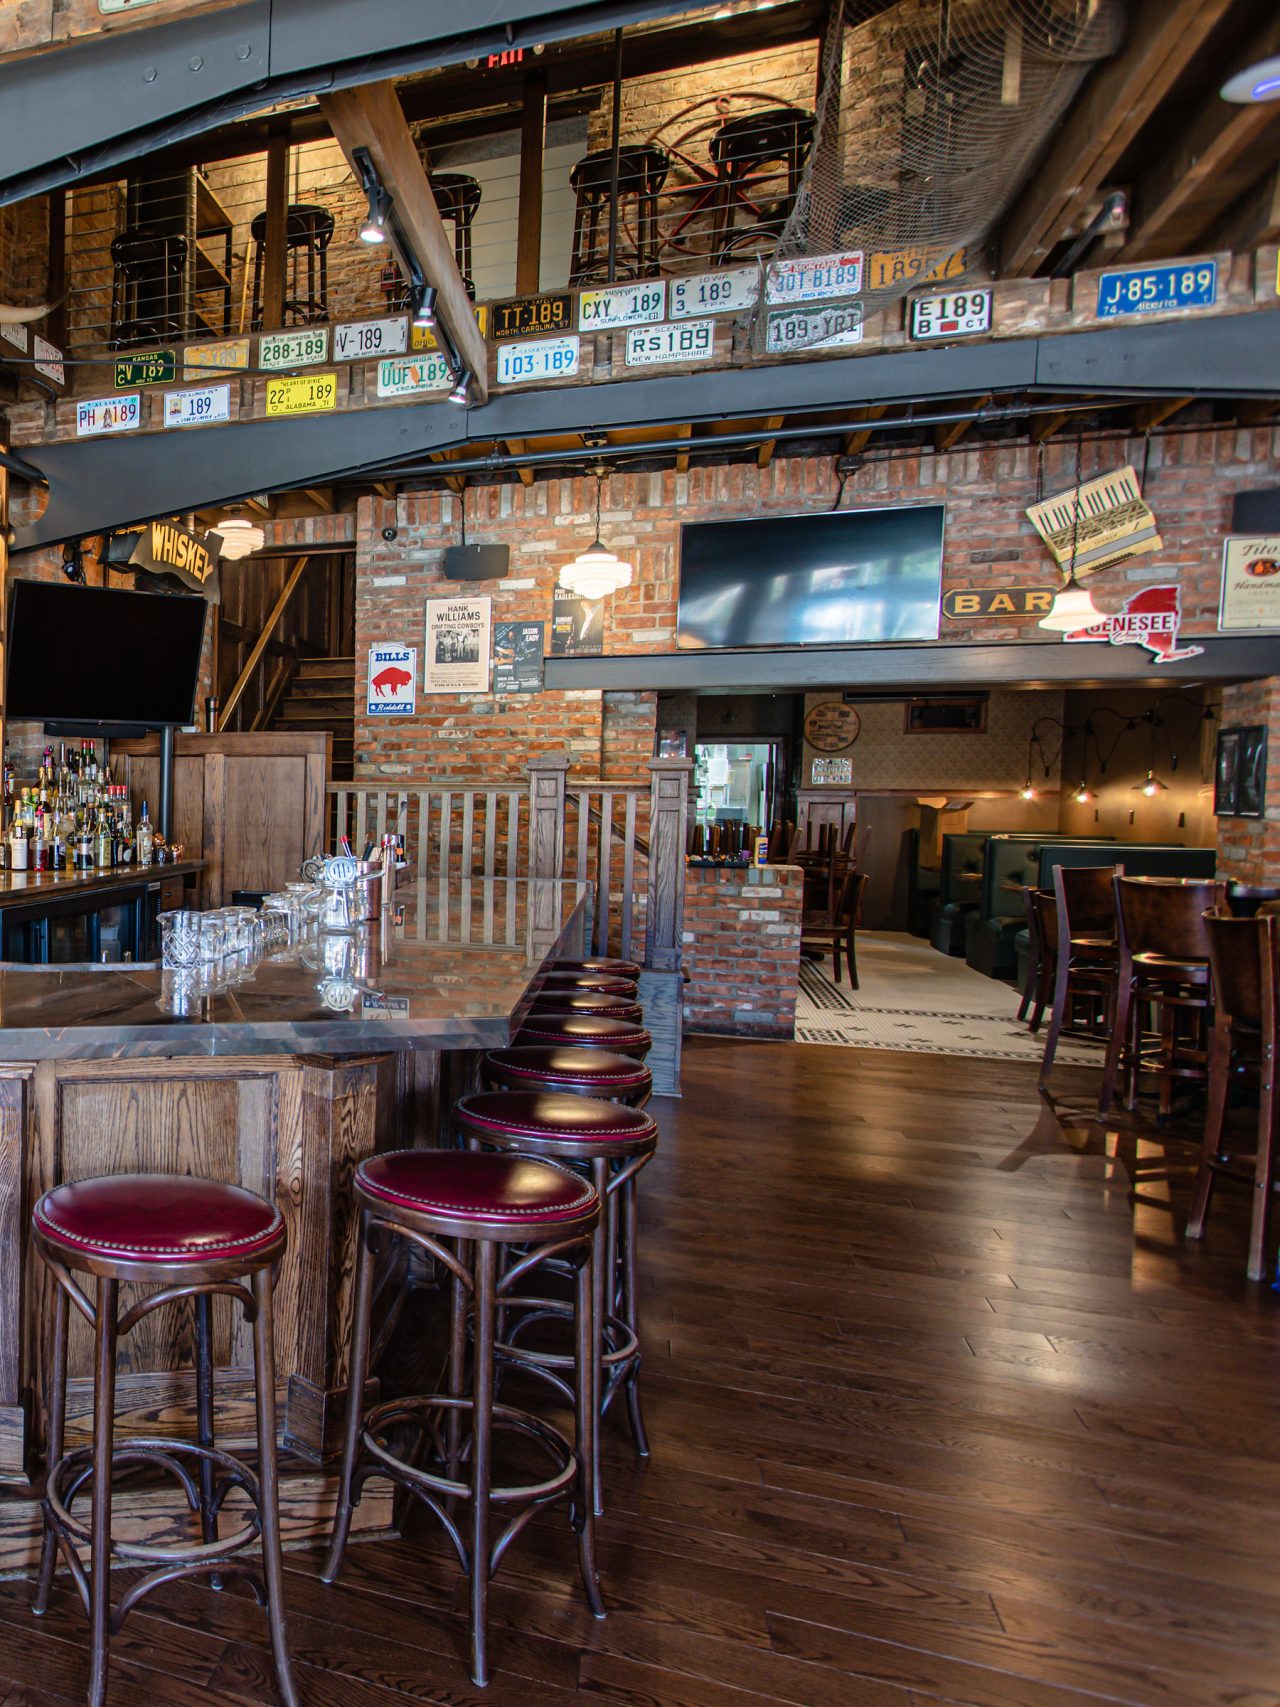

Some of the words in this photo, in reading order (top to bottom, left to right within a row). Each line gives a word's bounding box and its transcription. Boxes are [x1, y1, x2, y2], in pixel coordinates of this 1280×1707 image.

[699, 272, 730, 285] IOWA
[698, 280, 732, 303] 189
[582, 299, 612, 321] CXY
[630, 292, 661, 314] 189
[935, 293, 986, 320] 189
[1133, 299, 1178, 312] Alberta
[600, 312, 643, 325] SUNFLOWER
[965, 317, 985, 329] CT
[495, 328, 519, 337] NORTH
[520, 321, 556, 334] CAROLINA
[654, 322, 688, 334] SCENIC
[414, 338, 434, 347] OHIO
[133, 354, 159, 363] KANSAS
[398, 356, 433, 365] FLORIDA
[631, 354, 652, 363] NEW
[655, 349, 709, 361] HAMPSHIRE
[142, 359, 165, 379] 189
[417, 361, 448, 384] 189
[269, 389, 285, 405] 22
[309, 383, 332, 401] 189
[189, 396, 212, 417] 189
[285, 401, 317, 411] ALABAMA
[79, 408, 96, 428] PH
[112, 403, 137, 424] 189
[151, 521, 214, 585] WHISKEY
[447, 605, 469, 613] HANK
[953, 591, 1054, 615] BAR
[436, 611, 481, 622] WILLIAMS
[431, 622, 457, 631] DRIFTING
[456, 621, 485, 630] COWBOYS
[375, 651, 410, 662] BILLS
[376, 703, 405, 712] Riddell
